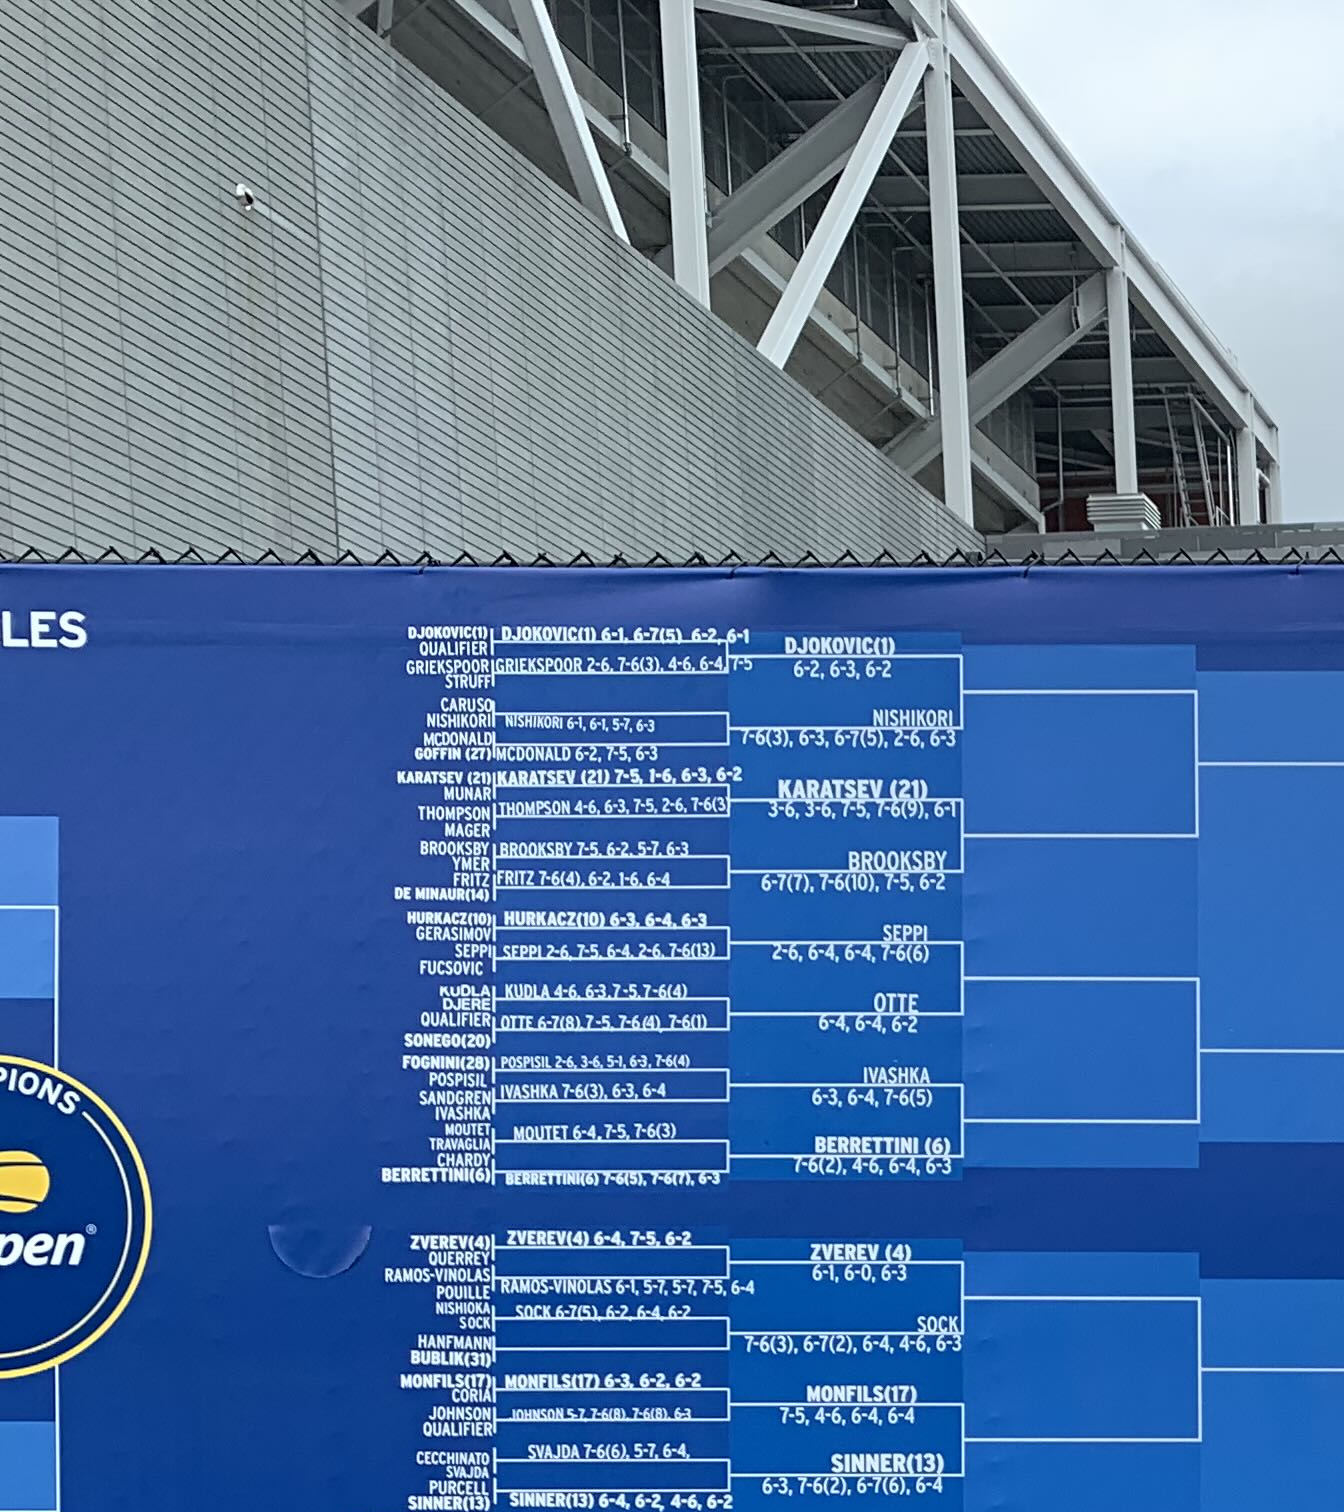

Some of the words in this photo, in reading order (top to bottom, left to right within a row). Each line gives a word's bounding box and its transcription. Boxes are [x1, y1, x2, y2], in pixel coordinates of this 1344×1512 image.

[2, 610, 87, 648] LES
[407, 625, 488, 640] DJOKOVIC(1)
[784, 636, 896, 656] DJOKOVIC(1)
[406, 659, 490, 675] GRIEKSPOOR
[865, 659, 892, 678] 6-2
[873, 709, 955, 728] NISHIKORI
[496, 746, 572, 762] MCDONALD
[635, 746, 658, 761] 6-3
[443, 786, 492, 801] MUNAR
[777, 778, 884, 799] KARATSEV
[889, 778, 928, 799] (21)
[417, 805, 491, 822] THOMPSON
[420, 840, 490, 856] BROOKSBY
[848, 850, 948, 871] BROOKSBY
[453, 872, 491, 888] FRITZ
[882, 924, 928, 942] SEPPI
[880, 944, 930, 964] 7-6(6)
[873, 992, 920, 1013] OTTE
[404, 1033, 491, 1049] SONEGO(20)
[402, 1056, 491, 1072] FOGNINI(28)
[429, 1071, 488, 1087] POSPISIL
[863, 1066, 931, 1084] IVASHKA
[883, 1088, 933, 1108] 7-6(5)
[435, 1106, 491, 1121] IVASHKA
[814, 1136, 919, 1155] BERRETTINI
[924, 1137, 951, 1155] (6)
[409, 1234, 491, 1251] ZVEREV(4)
[810, 1243, 880, 1262] ZVEREV
[884, 1243, 912, 1262] (4)
[384, 1267, 491, 1283] RAMOS-VINOLAS
[917, 1315, 960, 1333] SOCK
[410, 1349, 492, 1368] BUBLIK(31)
[806, 1385, 918, 1403] MONFILS(17)
[428, 1406, 492, 1421] JOHNSON
[887, 1406, 915, 1425] 6-4
[416, 1450, 490, 1466] CECCHINATO
[831, 1452, 945, 1474] SINNER(13)
[407, 1495, 491, 1511] SINNER(13)
